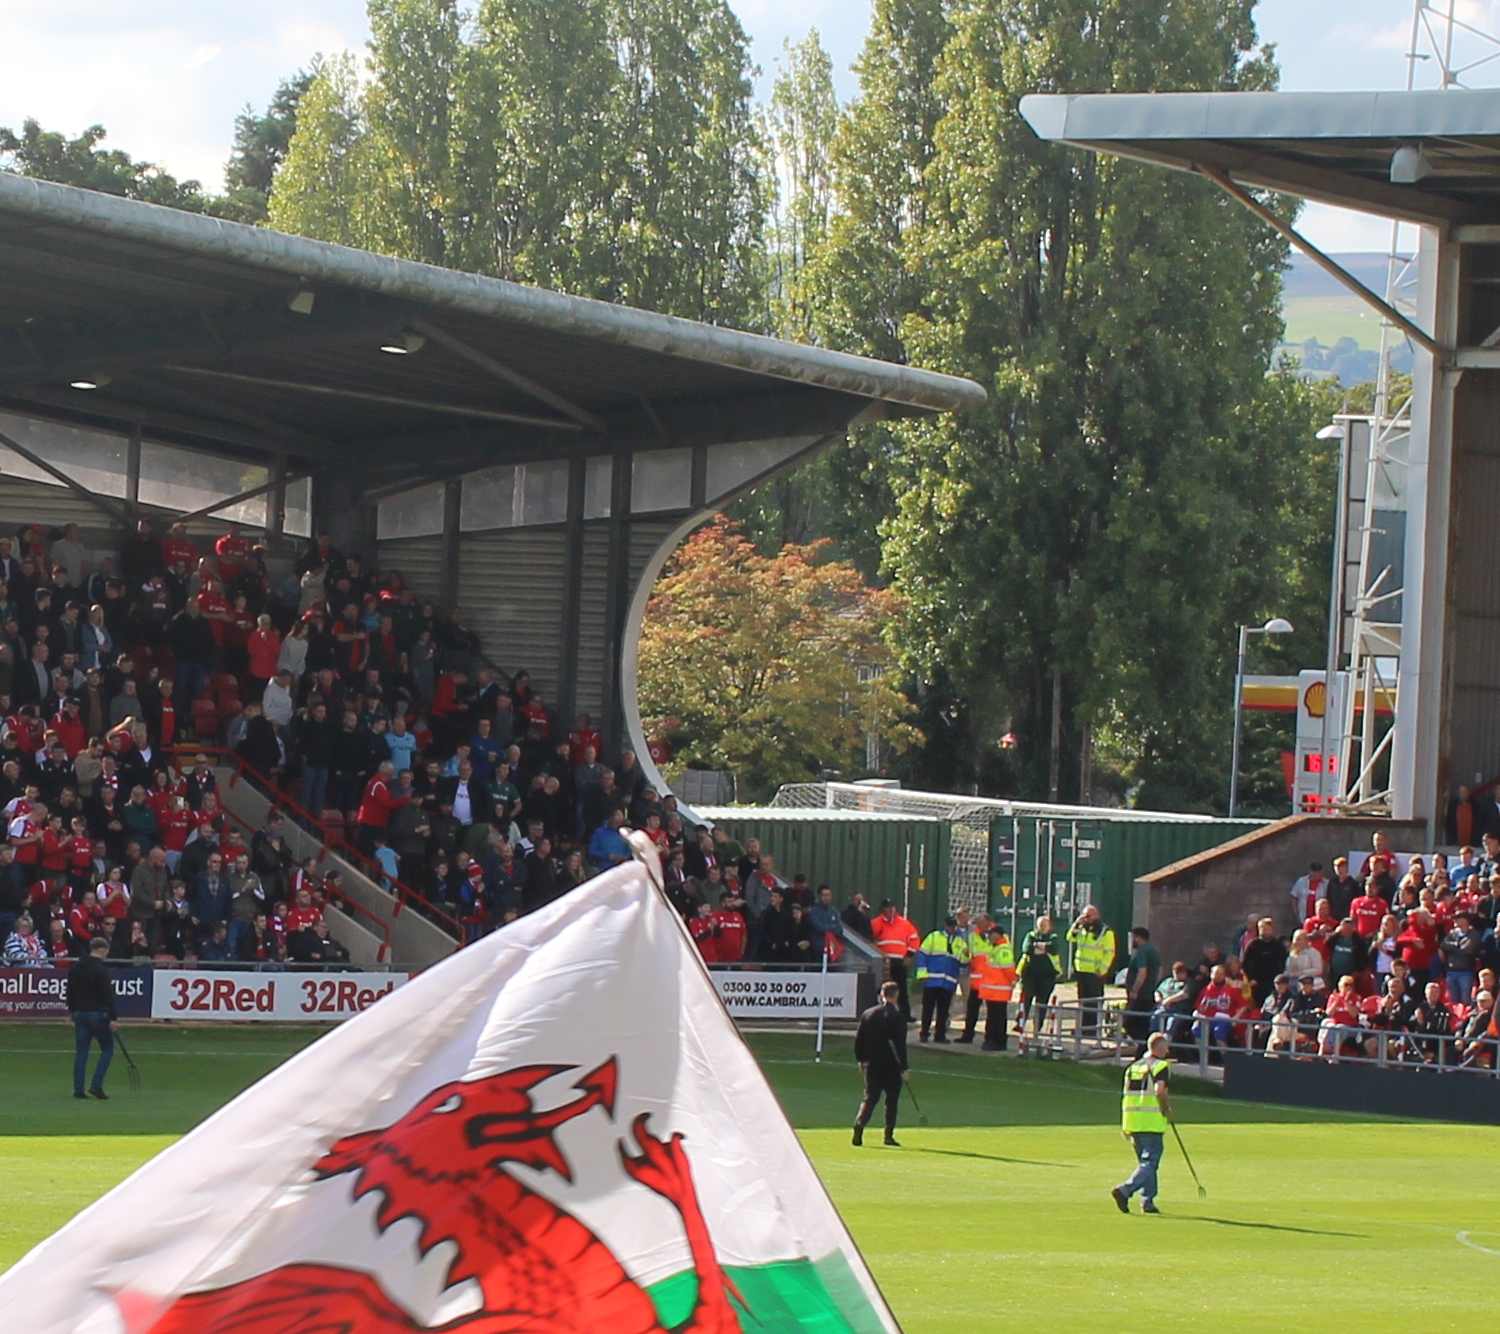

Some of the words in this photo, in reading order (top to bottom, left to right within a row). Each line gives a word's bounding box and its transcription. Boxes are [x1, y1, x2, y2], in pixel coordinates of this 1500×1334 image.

[28, 973, 68, 1000] Leag
[169, 978, 276, 1012] 32Red
[723, 982, 751, 993] 0300
[754, 983, 768, 993] 30
[769, 983, 783, 993] 30
[785, 982, 807, 994] 007
[15, 1000, 35, 1011] your
